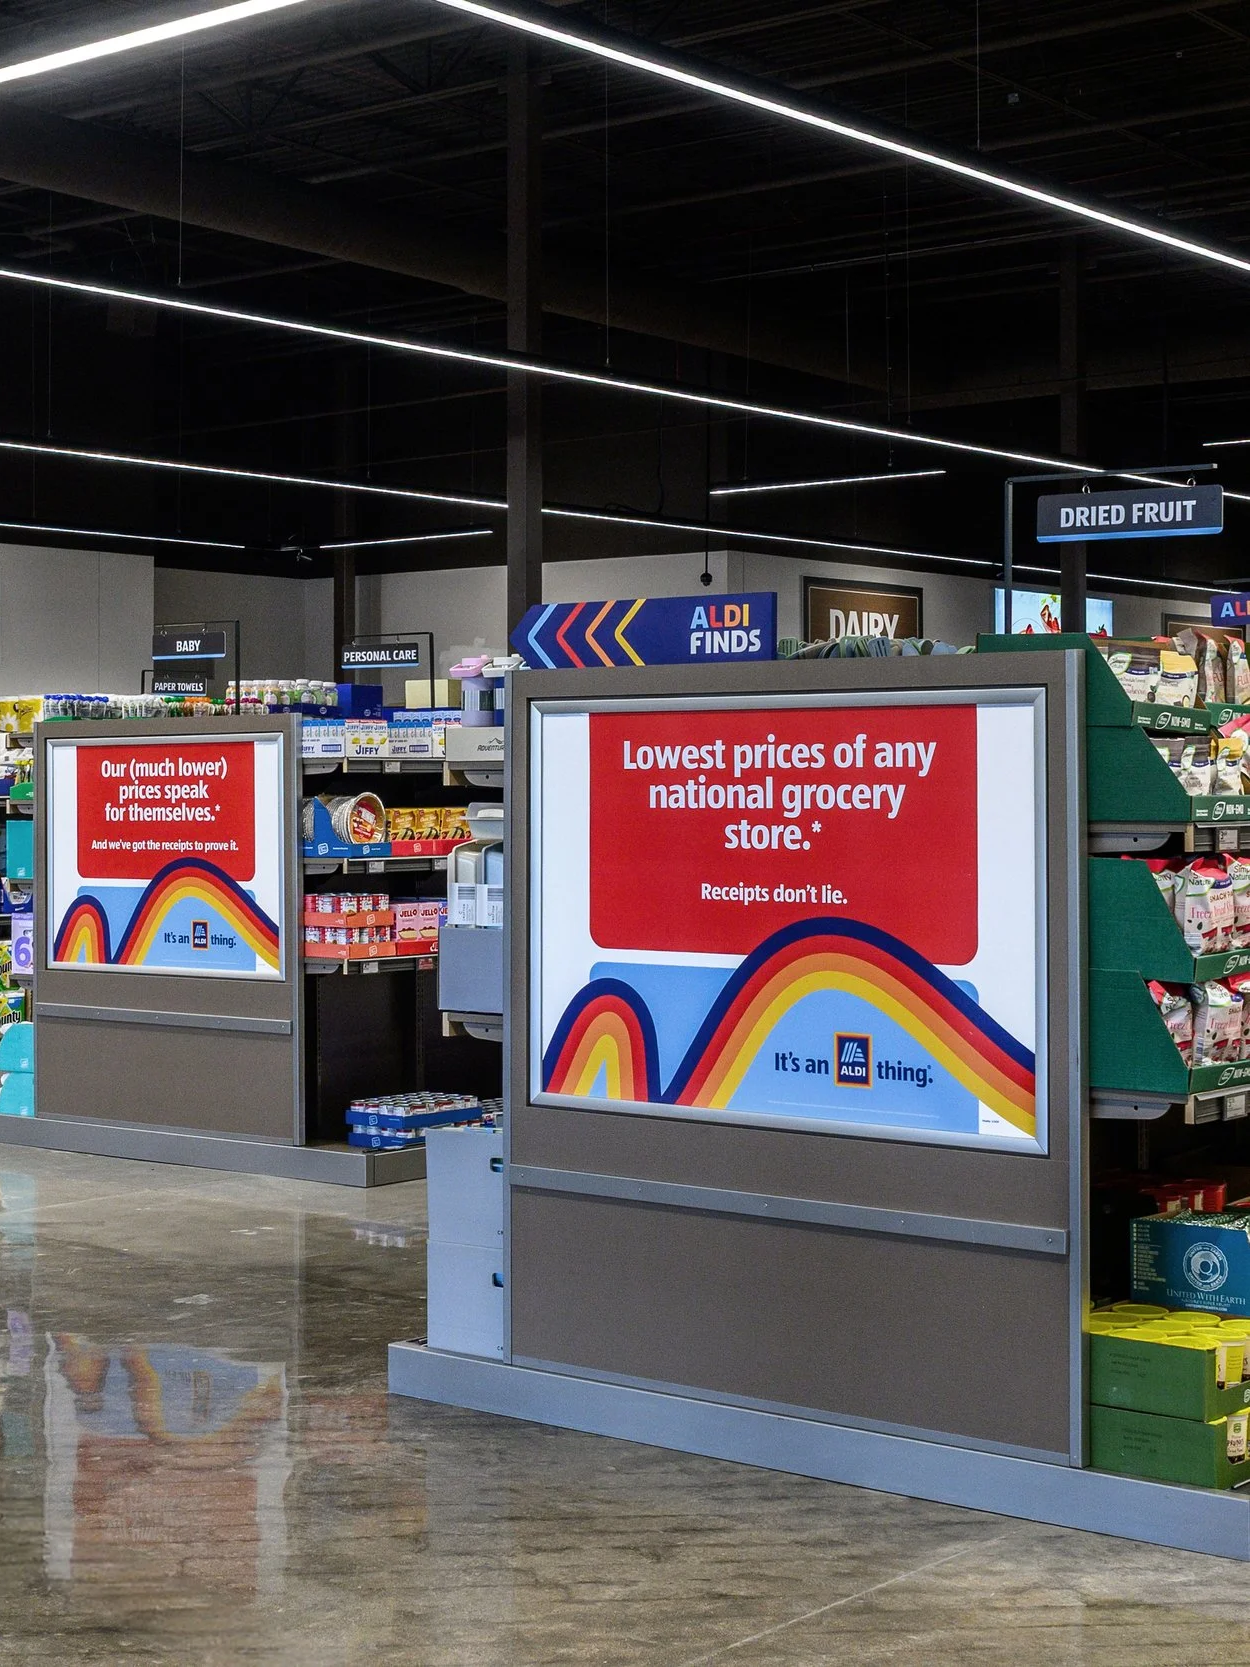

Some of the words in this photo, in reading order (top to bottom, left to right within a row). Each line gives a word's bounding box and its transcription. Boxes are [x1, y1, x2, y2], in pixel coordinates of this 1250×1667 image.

[1060, 504, 1125, 528] DRIED
[1132, 500, 1197, 524] FRUIT
[690, 604, 749, 629] ALDI
[830, 608, 900, 639] DAIRY
[176, 640, 201, 652] BABY
[690, 629, 762, 655] FINDS
[343, 650, 391, 662] PERSONAL
[393, 649, 417, 661] CARE
[154, 682, 177, 692] PAPER
[177, 682, 204, 692] TOWELS
[355, 745, 379, 755] JIFFY
[623, 739, 726, 770] Lowest
[733, 734, 825, 778] prices
[833, 733, 867, 769] of
[873, 741, 937, 777] any
[101, 760, 126, 778] Our
[129, 758, 175, 781] (much
[178, 756, 228, 780] lower)
[119, 780, 161, 804] prices
[164, 780, 209, 804] speak
[649, 775, 773, 809] national
[781, 783, 906, 819] grocery
[105, 802, 126, 821] for
[91, 839, 107, 850] And
[108, 839, 131, 850] we've
[132, 840, 146, 853] got
[146, 839, 160, 850] the
[161, 839, 194, 853] receipts
[194, 840, 203, 850] to
[204, 842, 229, 853] prove
[230, 839, 239, 851] it.
[701, 882, 770, 906] Receipts
[773, 884, 818, 904] don't
[821, 884, 848, 905] lie.
[164, 931, 177, 944] It's
[178, 934, 190, 944] an
[194, 937, 207, 945] ALDI
[14, 936, 31, 968] 6
[774, 1051, 800, 1073] It's
[805, 1057, 829, 1075] an
[840, 1065, 866, 1077] ALDI
